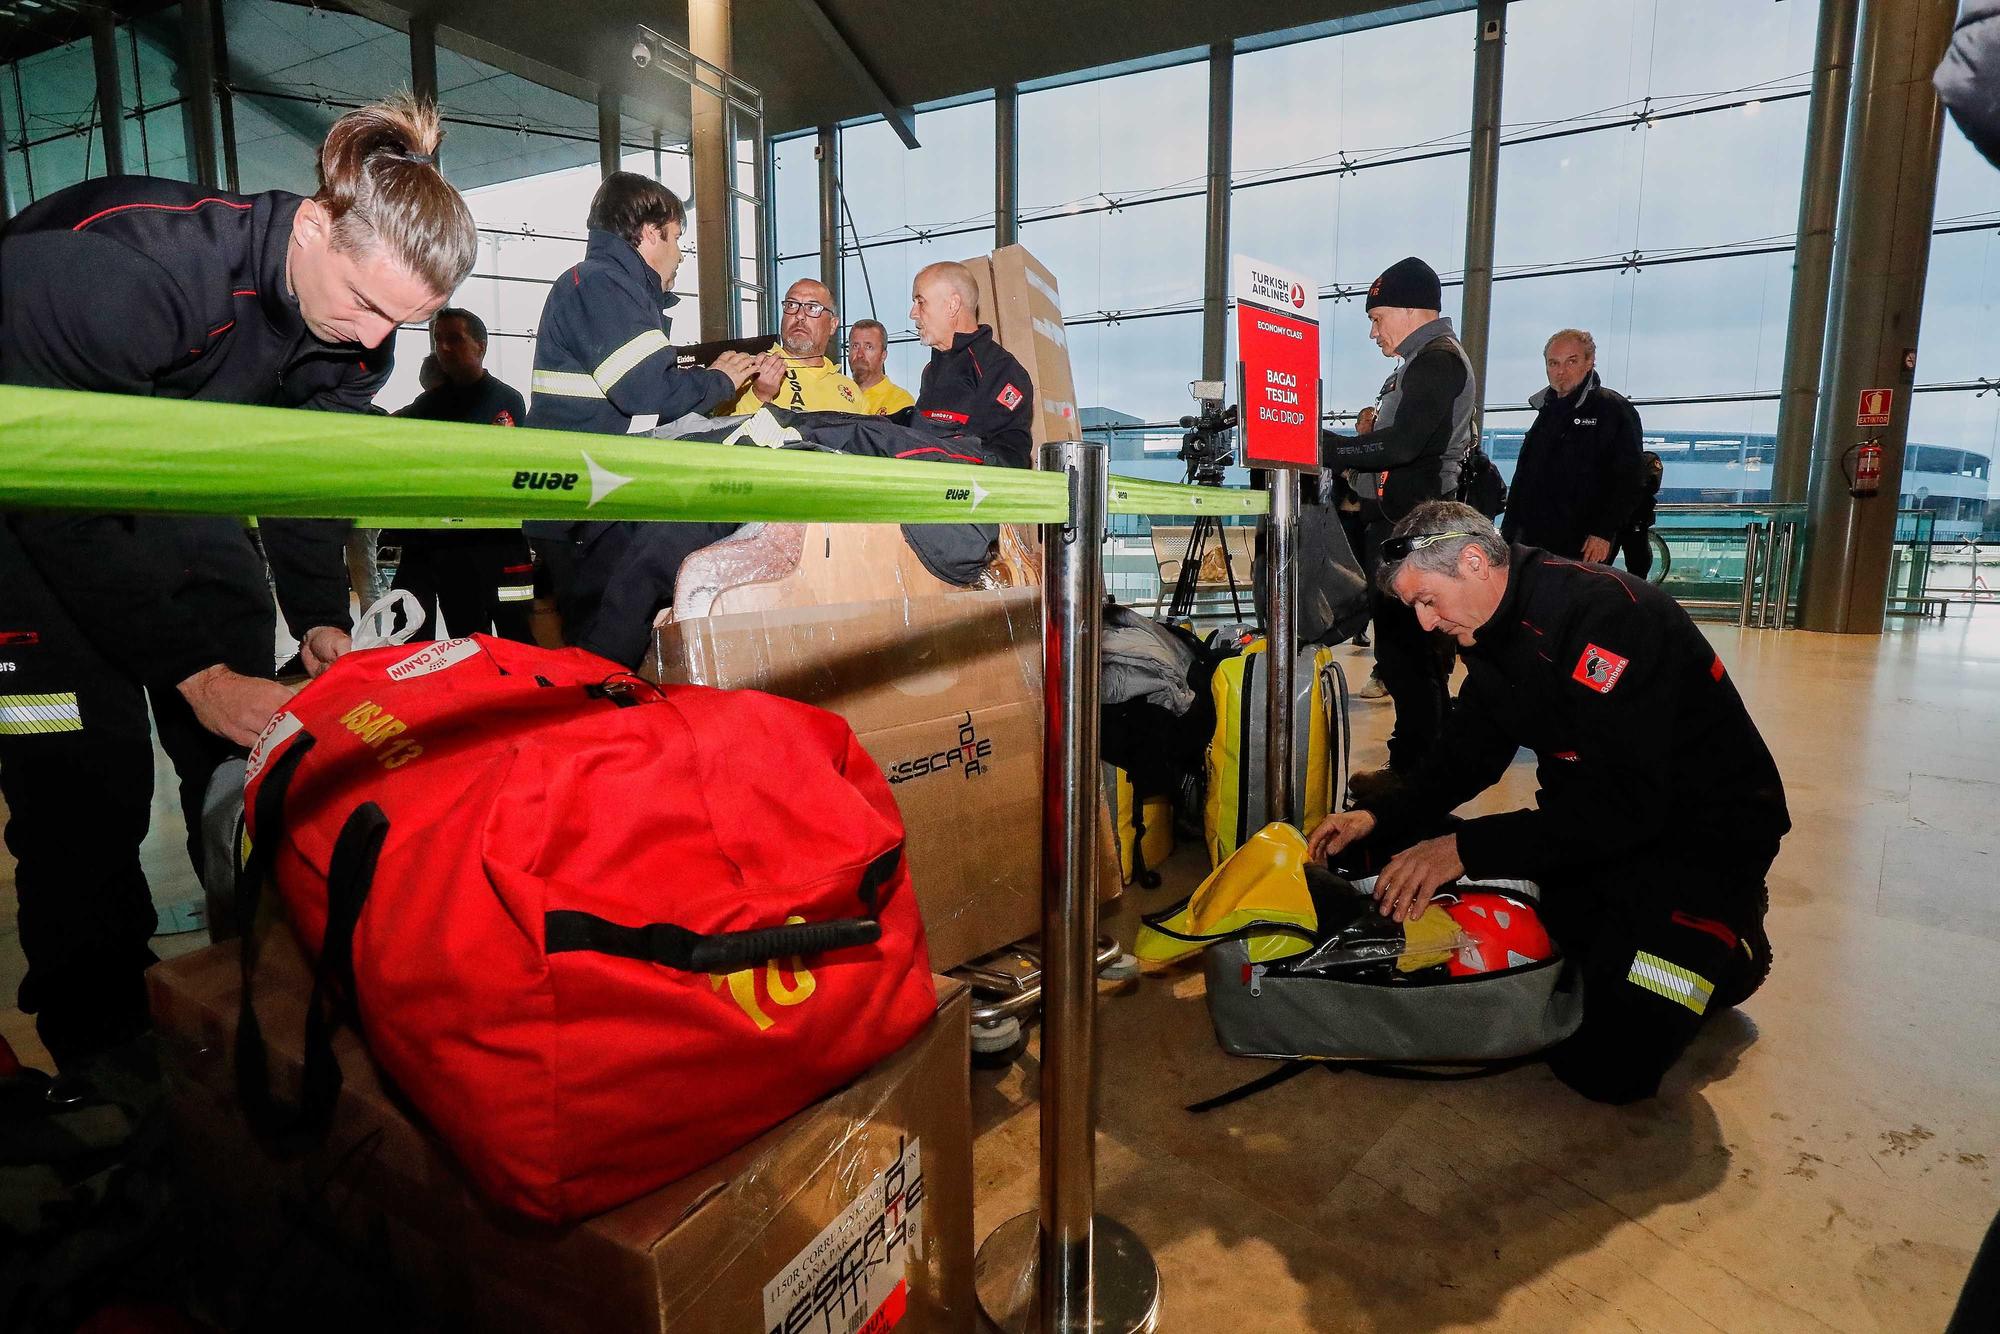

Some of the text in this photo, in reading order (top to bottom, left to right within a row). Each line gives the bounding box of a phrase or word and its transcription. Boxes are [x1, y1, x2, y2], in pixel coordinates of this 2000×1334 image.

[1251, 270, 1289, 292] TURKISH
[1252, 283, 1289, 303] AIRLINES
[1257, 320, 1303, 340] ECONOMY CLASS
[1266, 369, 1297, 388] BAGAJ
[786, 369, 806, 412] USA
[1265, 387, 1299, 405] TESLİM
[1259, 406, 1305, 425] BAG DROP
[1859, 415, 1889, 425] EXTINTOR
[512, 471, 579, 491] aena
[945, 488, 970, 501] aena
[390, 653, 432, 679] CANIN
[1600, 658, 1626, 694] Bombers
[339, 700, 424, 769] USAR 13
[769, 1267, 801, 1303] 1150R
